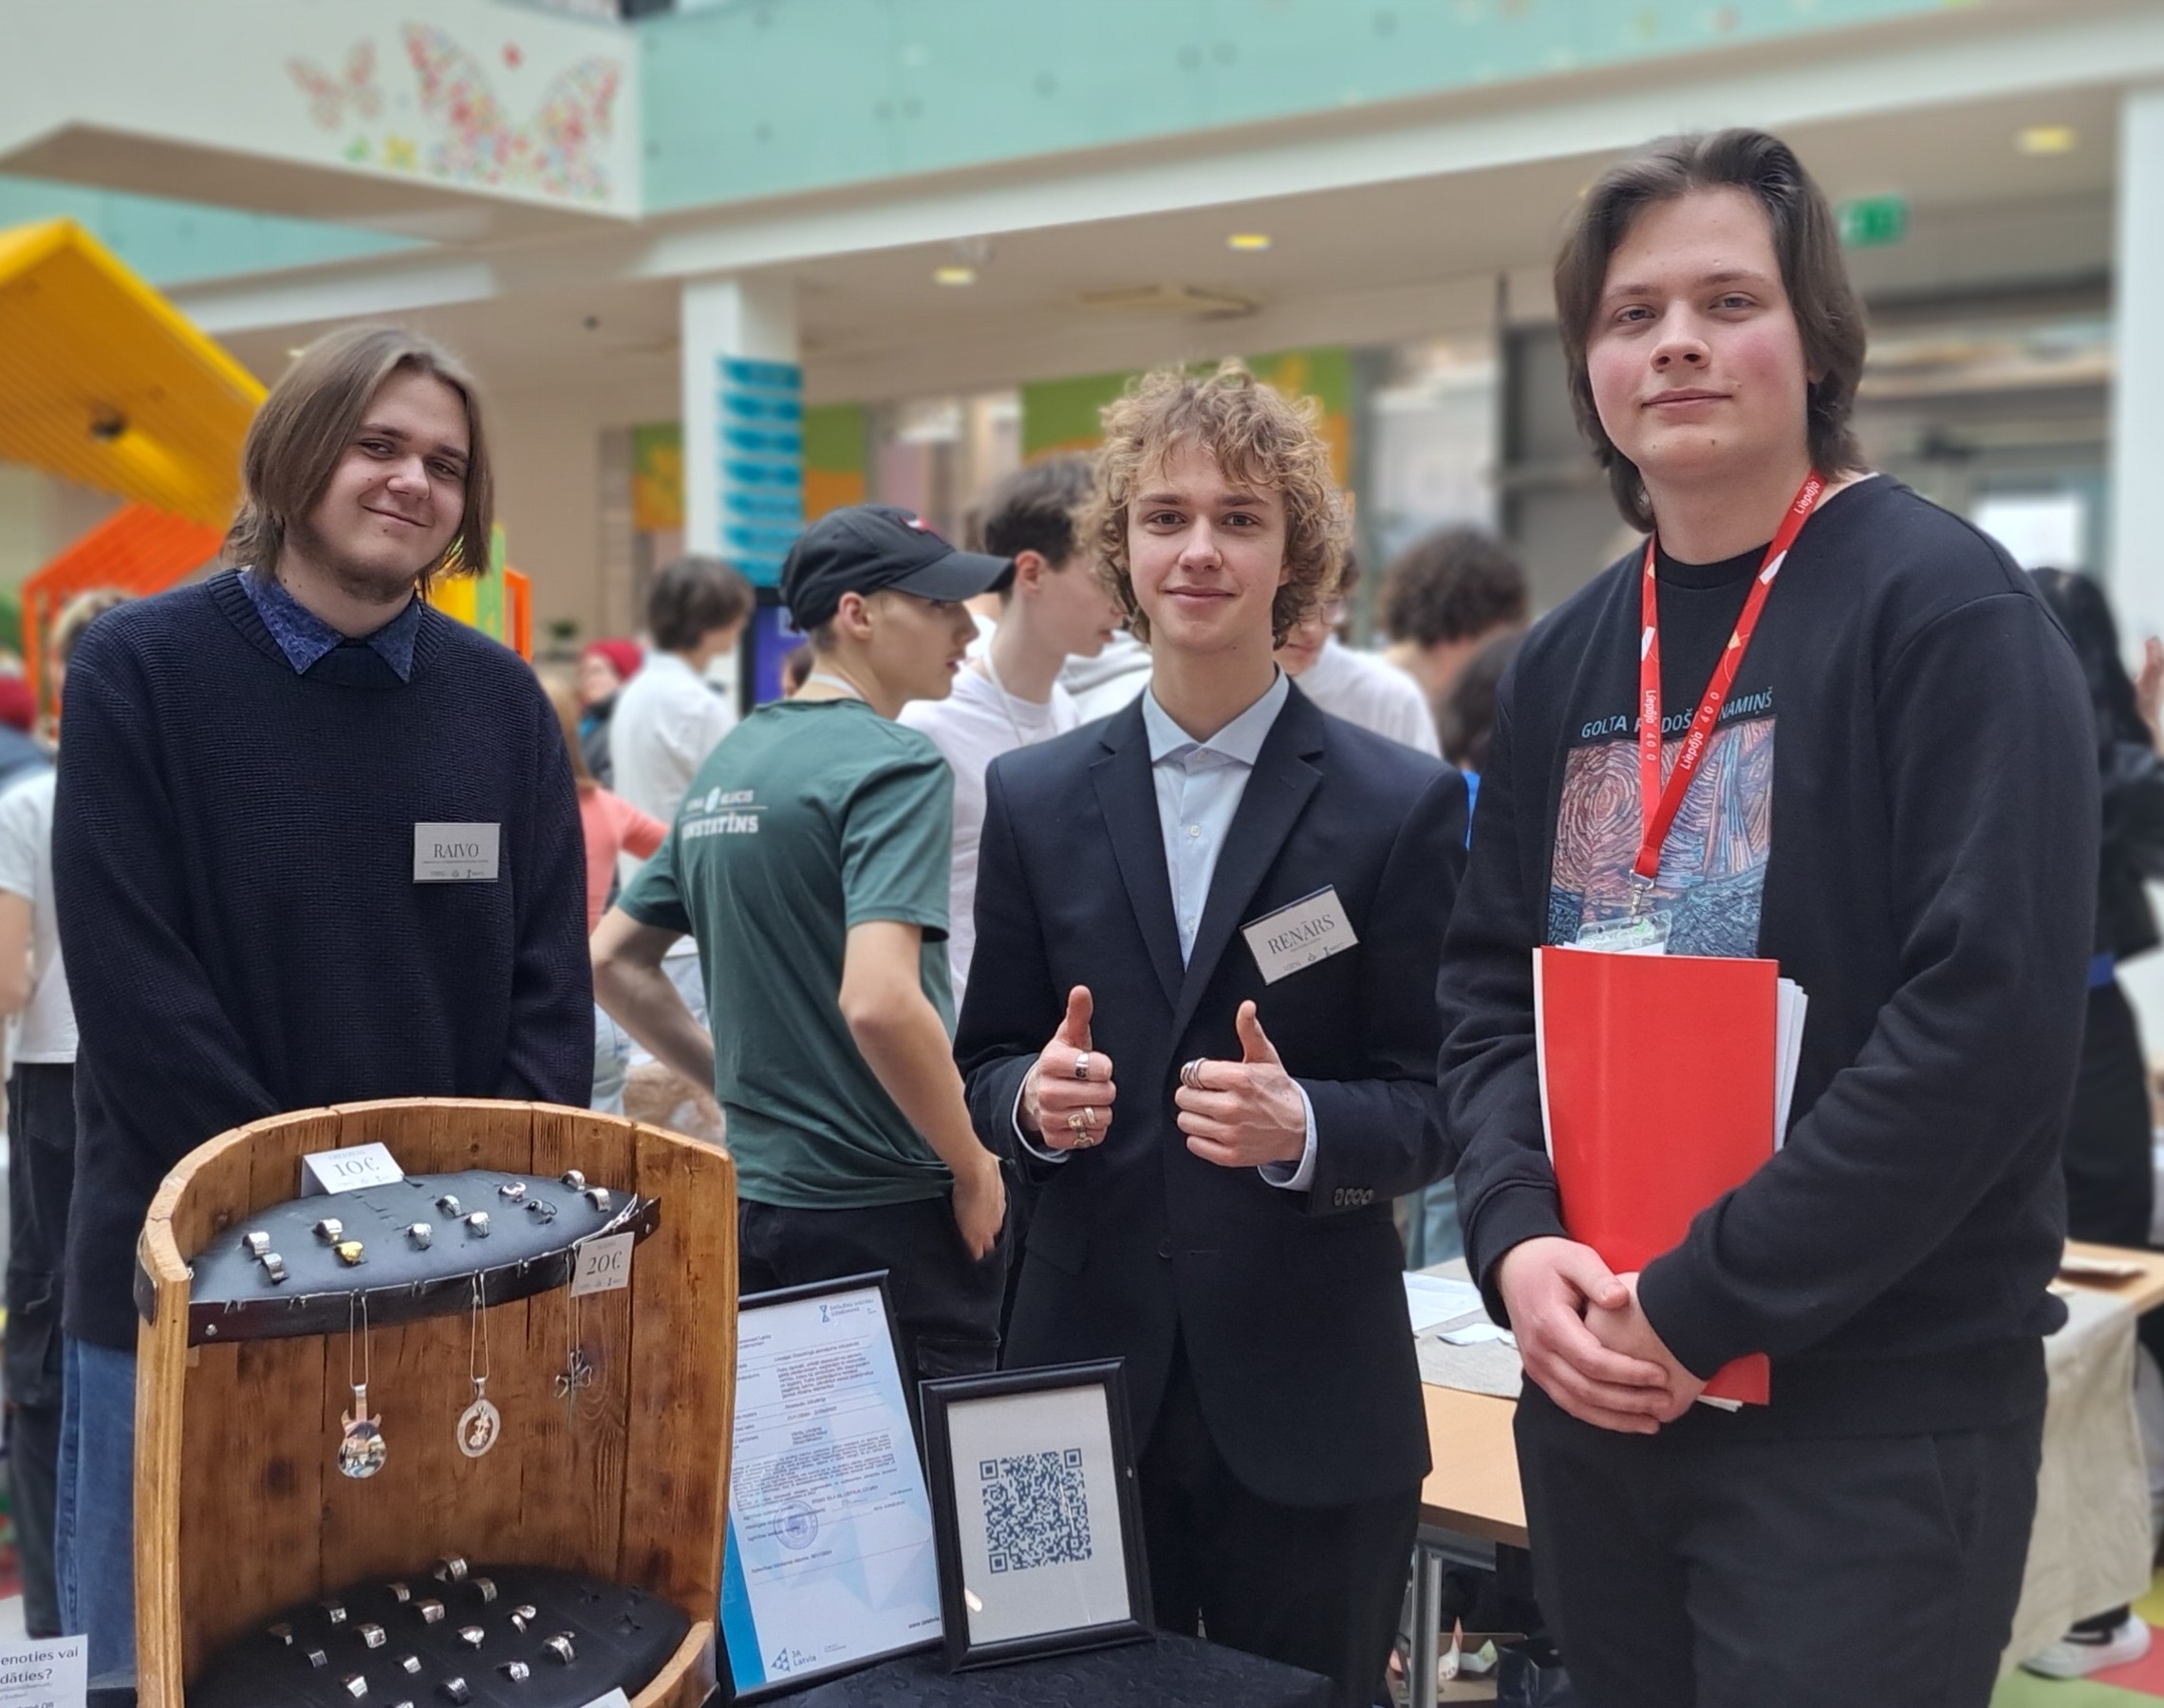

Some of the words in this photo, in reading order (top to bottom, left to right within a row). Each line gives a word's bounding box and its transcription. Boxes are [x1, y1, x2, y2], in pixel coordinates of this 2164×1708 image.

[1581, 715, 1628, 738] GOLTA
[433, 842, 479, 859] RAIVO
[1268, 914, 1335, 955] RENĀRS
[1, 1650, 54, 1666] enoties
[58, 1646, 79, 1660] vai
[793, 1655, 817, 1667] Latvia
[0, 1668, 53, 1684] dāties?
